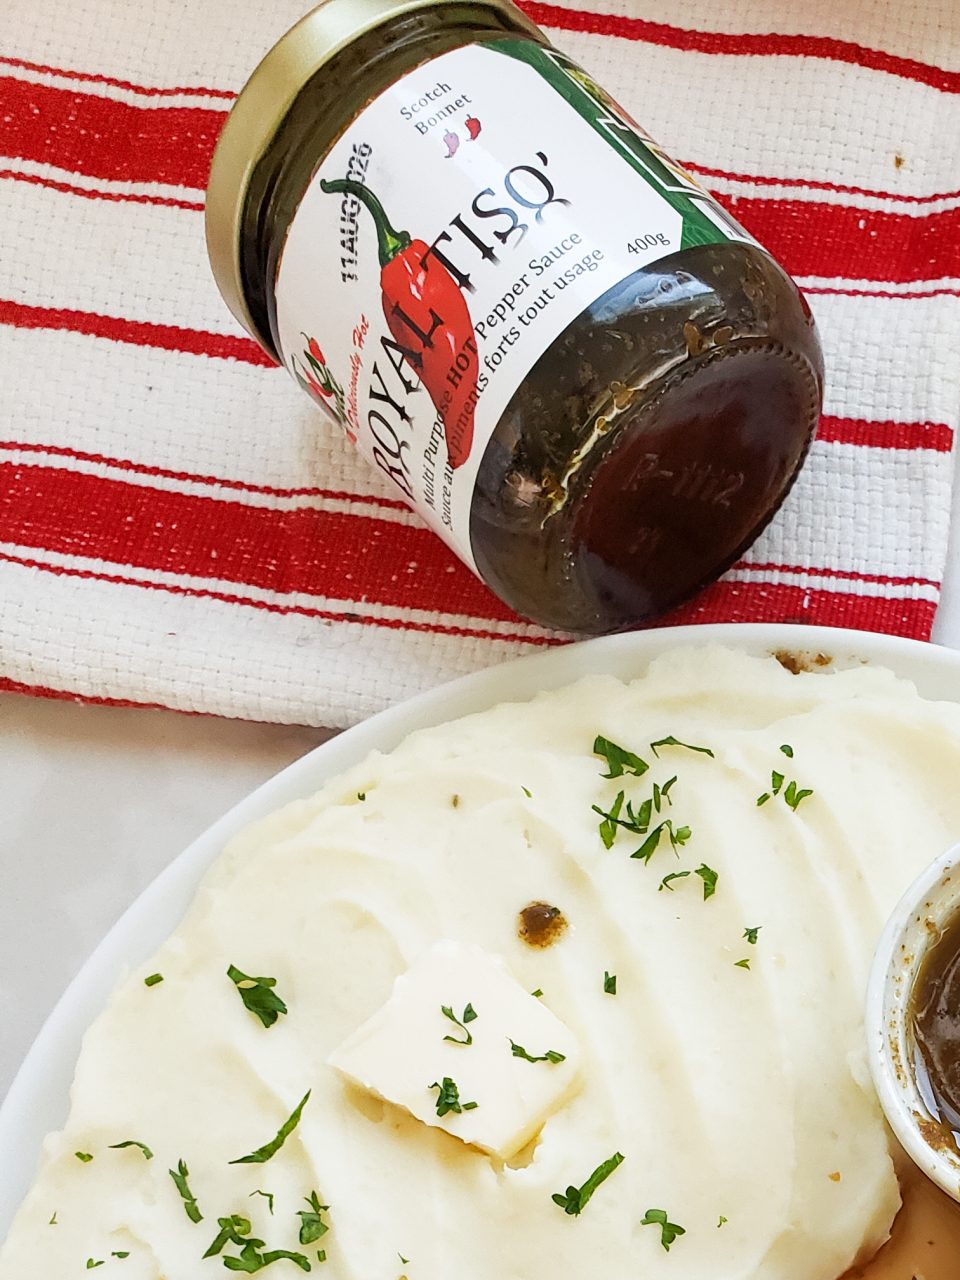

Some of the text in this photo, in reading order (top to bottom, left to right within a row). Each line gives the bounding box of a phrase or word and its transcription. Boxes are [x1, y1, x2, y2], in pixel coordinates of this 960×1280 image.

[400, 81, 451, 121] Scotch
[414, 93, 472, 135] Bonnet
[626, 231, 671, 256] 400g
[353, 313, 369, 350] Hot
[422, 233, 582, 510] Multi Purpose HOT Pepper Sauce
[443, 454, 456, 485] aux
[450, 372, 489, 454] piments
[484, 326, 521, 373] forts
[518, 289, 555, 326] tout
[554, 249, 604, 290] usage
[368, 304, 444, 503] ROYAL
